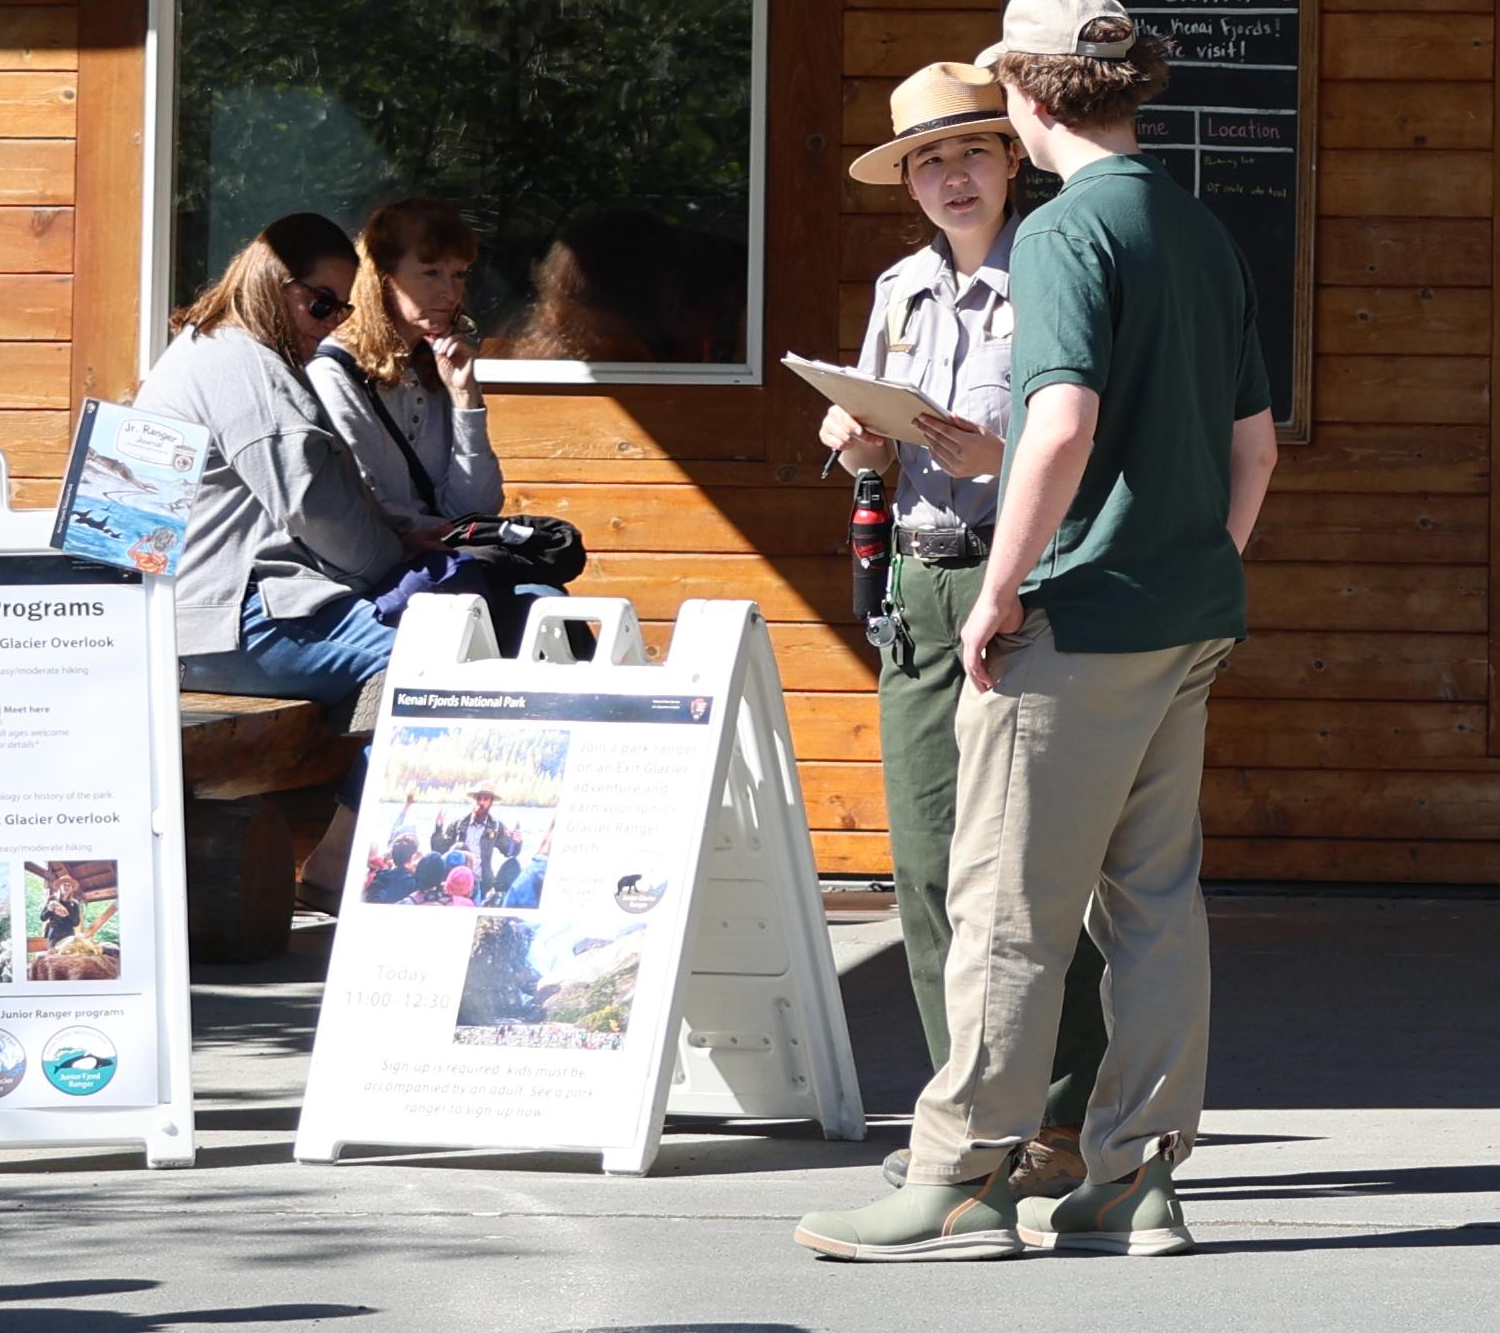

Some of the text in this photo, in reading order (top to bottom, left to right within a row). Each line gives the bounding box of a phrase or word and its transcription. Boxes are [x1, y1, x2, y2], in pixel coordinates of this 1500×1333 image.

[1171, 18, 1213, 36] Kenai
[1220, 17, 1281, 42] Fjords!
[1197, 40, 1246, 62] visit!
[1208, 117, 1281, 140] Location
[124, 422, 178, 443] Jr. Ranger
[0, 637, 47, 649] Glacier
[50, 636, 115, 648] Overlook
[62, 665, 89, 676] hiking
[397, 693, 527, 710] Kenai Fjords National Park
[3, 706, 27, 714] Meet
[8, 730, 29, 738] ages
[30, 728, 70, 737] welcome
[580, 741, 606, 753] Join
[610, 744, 618, 753] a
[620, 743, 649, 756] park
[576, 761, 689, 775] on an Exit Glacier
[572, 782, 668, 795] adventure and
[33, 792, 64, 802] history
[65, 792, 75, 800] of
[77, 791, 91, 800] the
[92, 791, 112, 801] park
[569, 804, 598, 813] earn
[603, 804, 632, 815] your
[4, 813, 53, 825] Glacier
[56, 812, 121, 824] Overlook
[566, 821, 660, 836] Glacier Ranger
[65, 843, 93, 853] hiking
[377, 964, 428, 986] Today
[347, 991, 392, 1007] 11:00
[404, 992, 452, 1009] 12:30
[0, 1010, 33, 1020] Junior
[35, 1010, 72, 1021] Ranger
[74, 1009, 125, 1021] programs
[82, 1072, 101, 1081] Fjord
[433, 1062, 443, 1073] is
[506, 1063, 532, 1077] kids
[535, 1065, 568, 1078] must
[570, 1065, 586, 1078] be
[68, 1081, 94, 1089] Ranger
[363, 1080, 450, 1094] accompanied
[451, 1082, 468, 1096] by
[469, 1084, 486, 1095] an
[530, 1084, 551, 1097] See
[554, 1088, 563, 1098] a
[565, 1086, 594, 1100] park
[403, 1103, 447, 1118] ranger
[449, 1104, 462, 1115] to
[465, 1104, 492, 1119] sign
